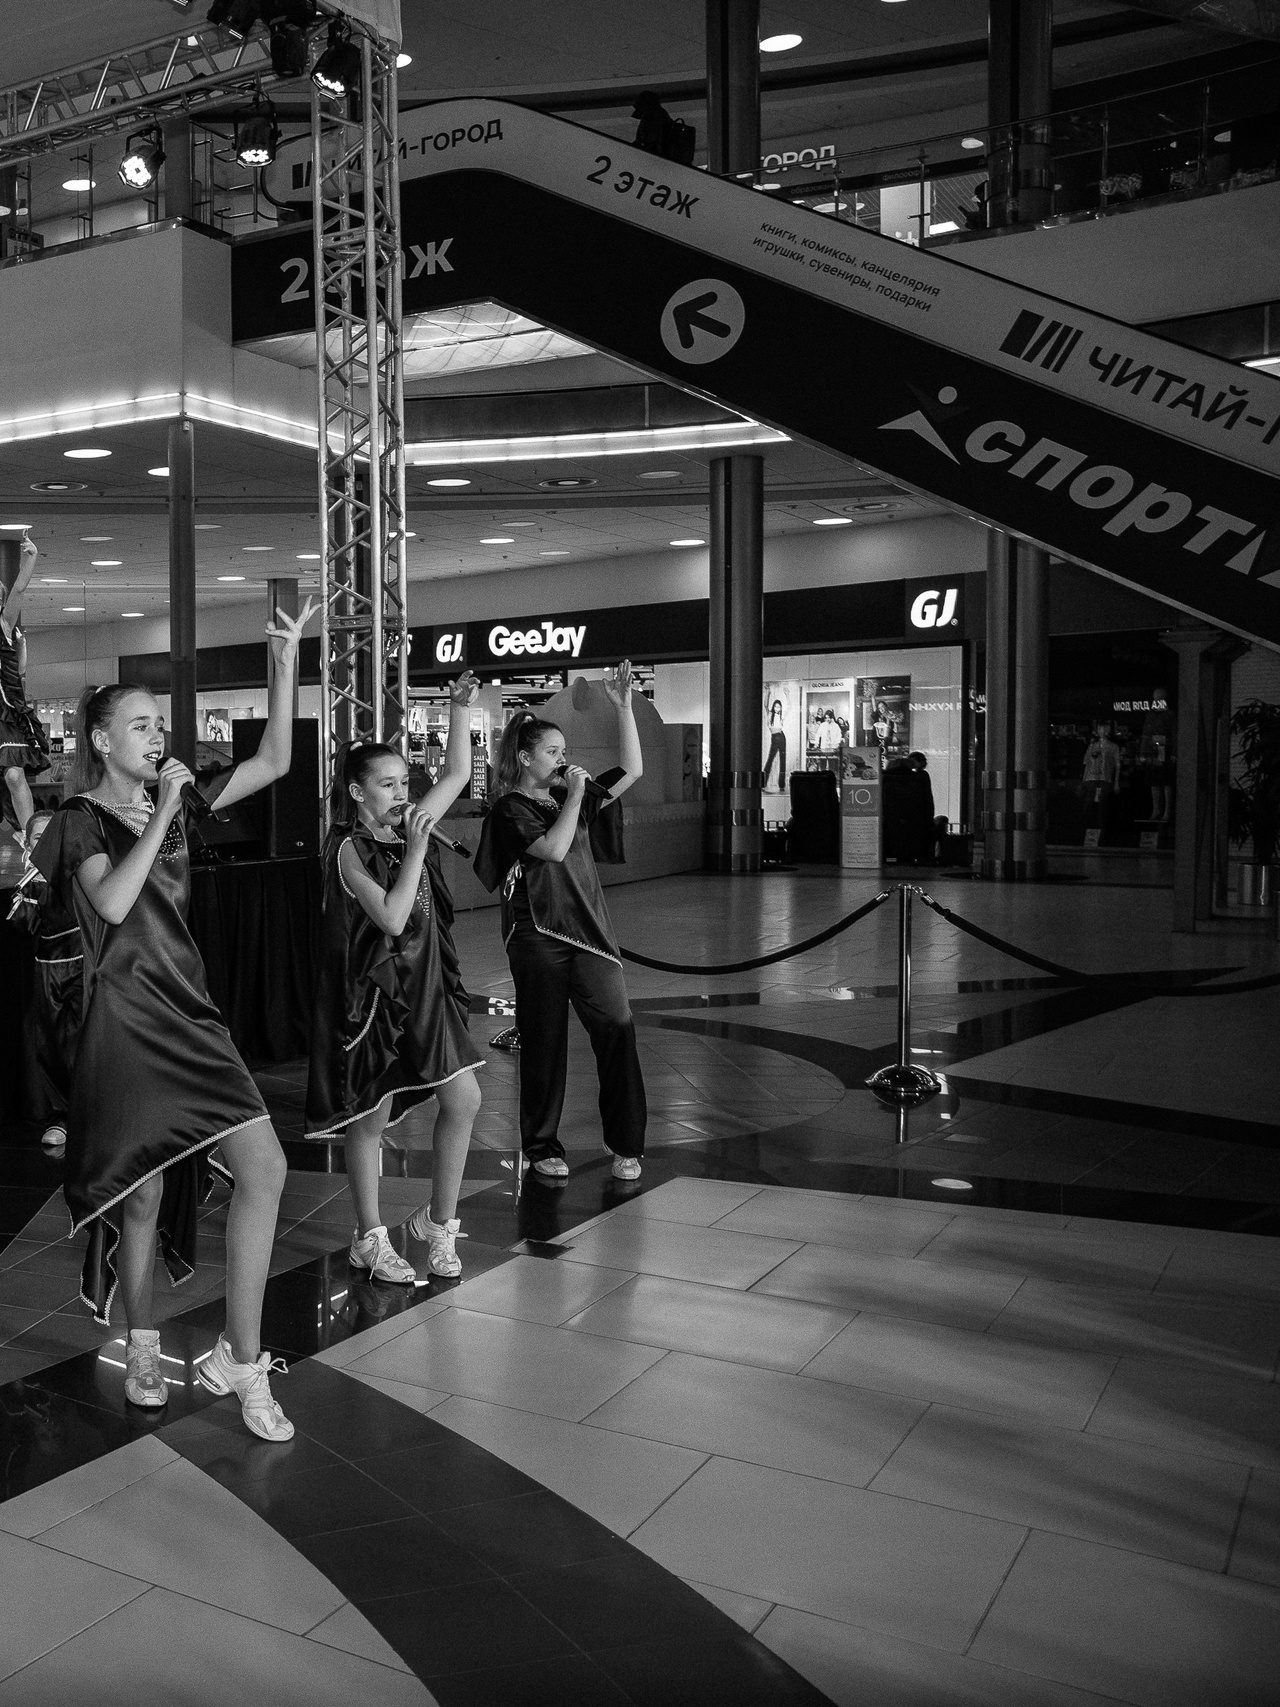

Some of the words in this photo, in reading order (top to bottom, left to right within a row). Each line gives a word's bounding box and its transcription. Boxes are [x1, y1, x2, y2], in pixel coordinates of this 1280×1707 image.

[587, 155, 612, 187] 2
[614, 166, 699, 218] этаж
[760, 145, 837, 174] ОРОД
[280, 257, 310, 304] 2
[753, 237, 806, 264] игрушки,
[809, 259, 872, 290] сувениры,
[875, 284, 931, 312] подарки
[760, 222, 797, 244] книги,
[801, 237, 858, 266] комиксы,
[861, 260, 940, 297] канцелярия
[488, 622, 586, 657] GeeJay
